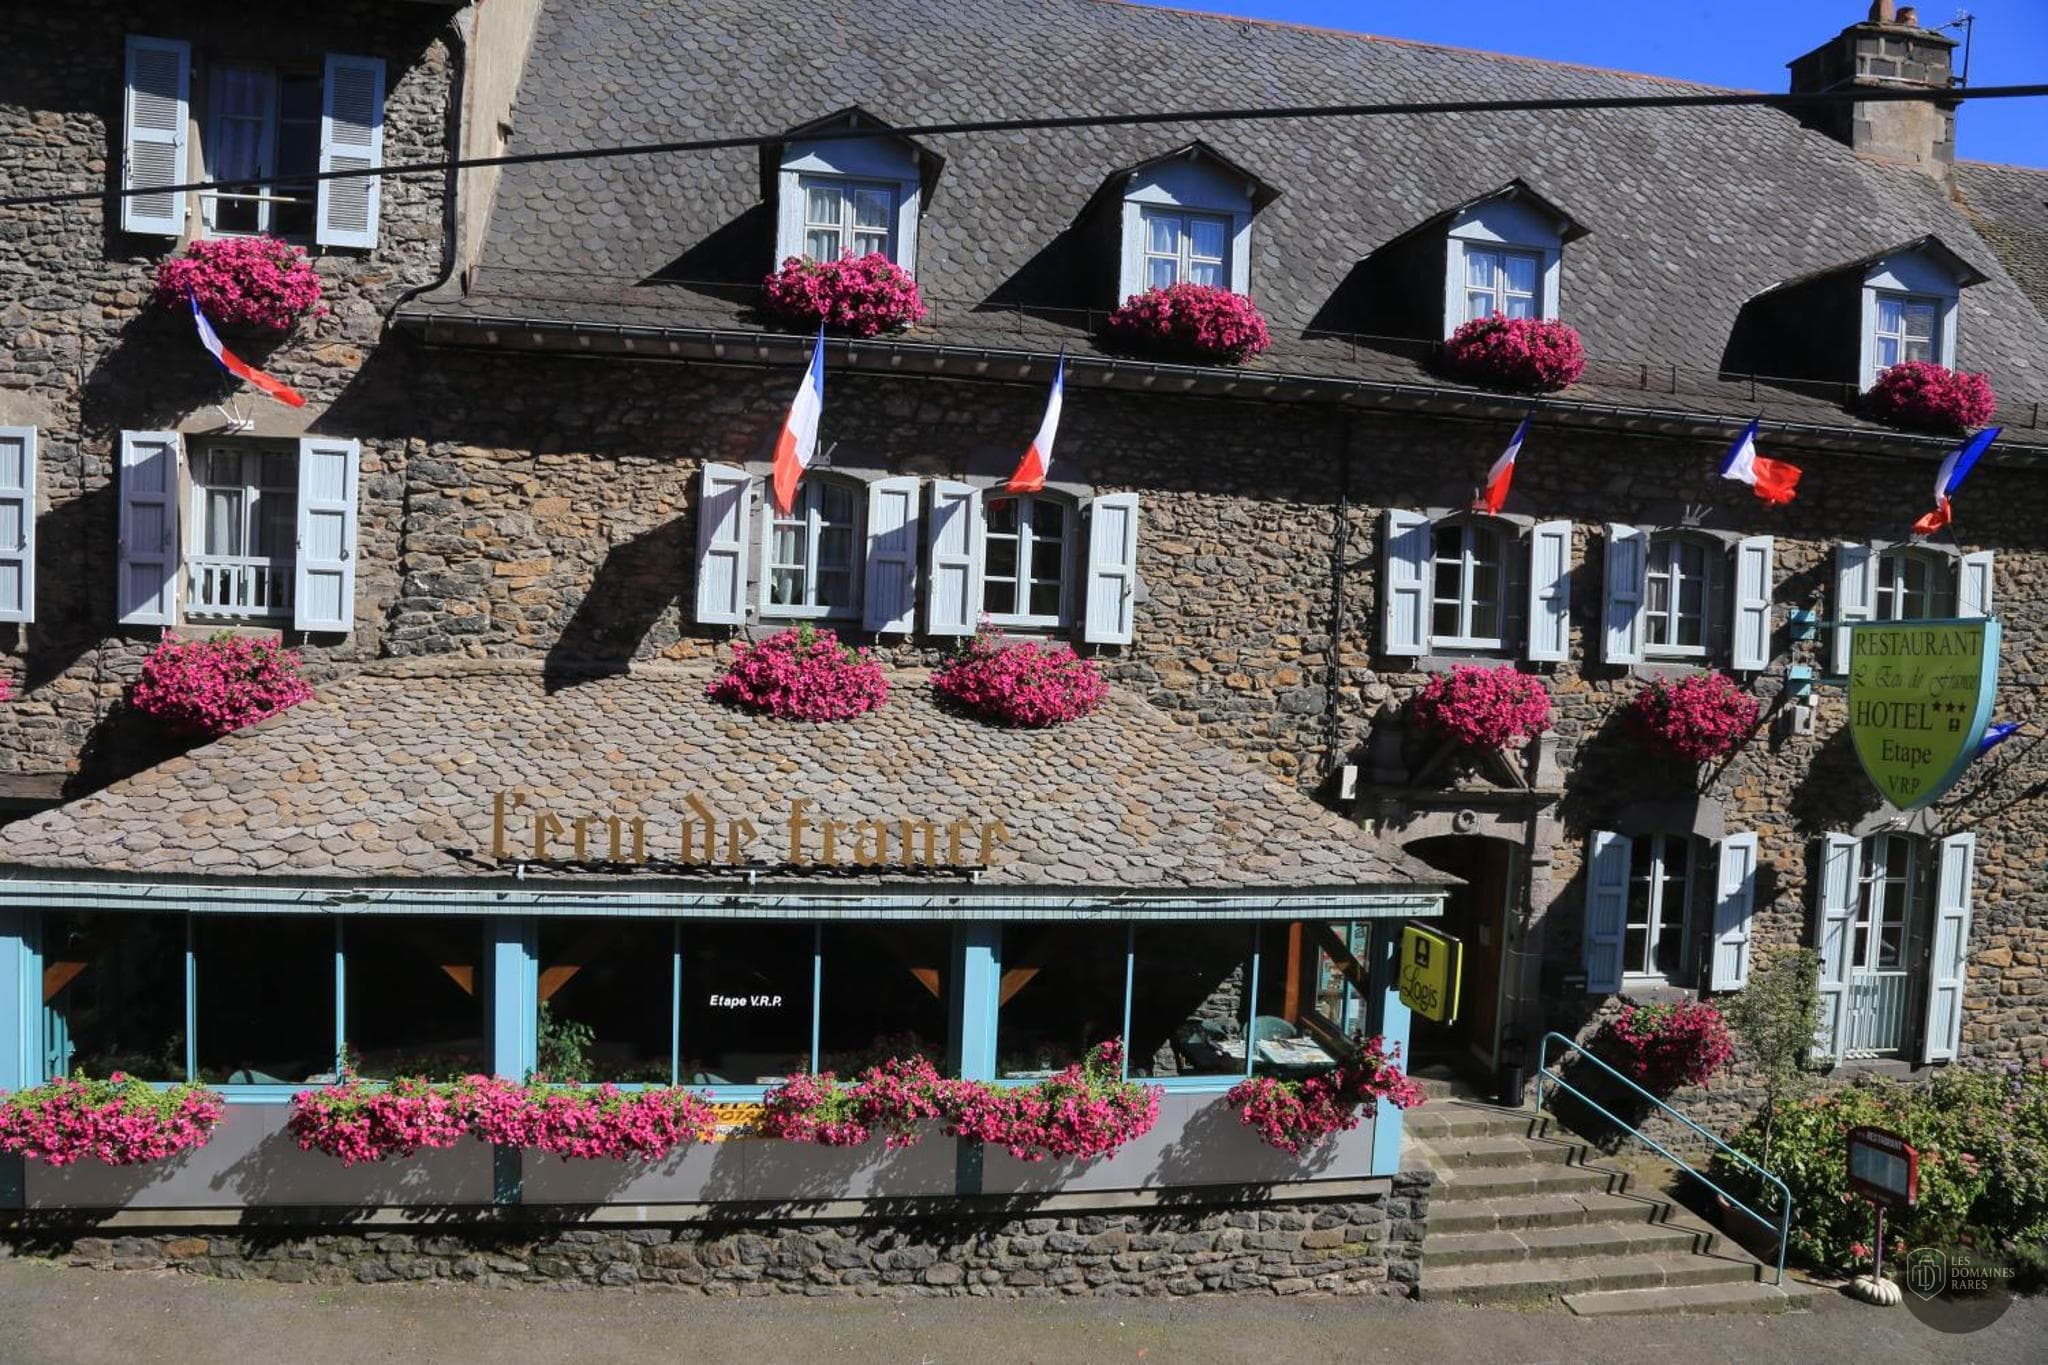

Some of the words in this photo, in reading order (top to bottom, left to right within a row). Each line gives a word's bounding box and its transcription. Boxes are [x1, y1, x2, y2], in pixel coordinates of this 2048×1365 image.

[1855, 631, 1983, 656] RESTAURANT
[1856, 701, 1933, 731] HOTEL
[1881, 739, 1932, 769] Etape
[1888, 775, 1921, 796] VRP
[680, 792, 759, 866] de
[786, 797, 1012, 868] france
[709, 994, 748, 1009] Etape
[750, 995, 782, 1007] V.R.P.
[1400, 964, 1437, 1011] Logis
